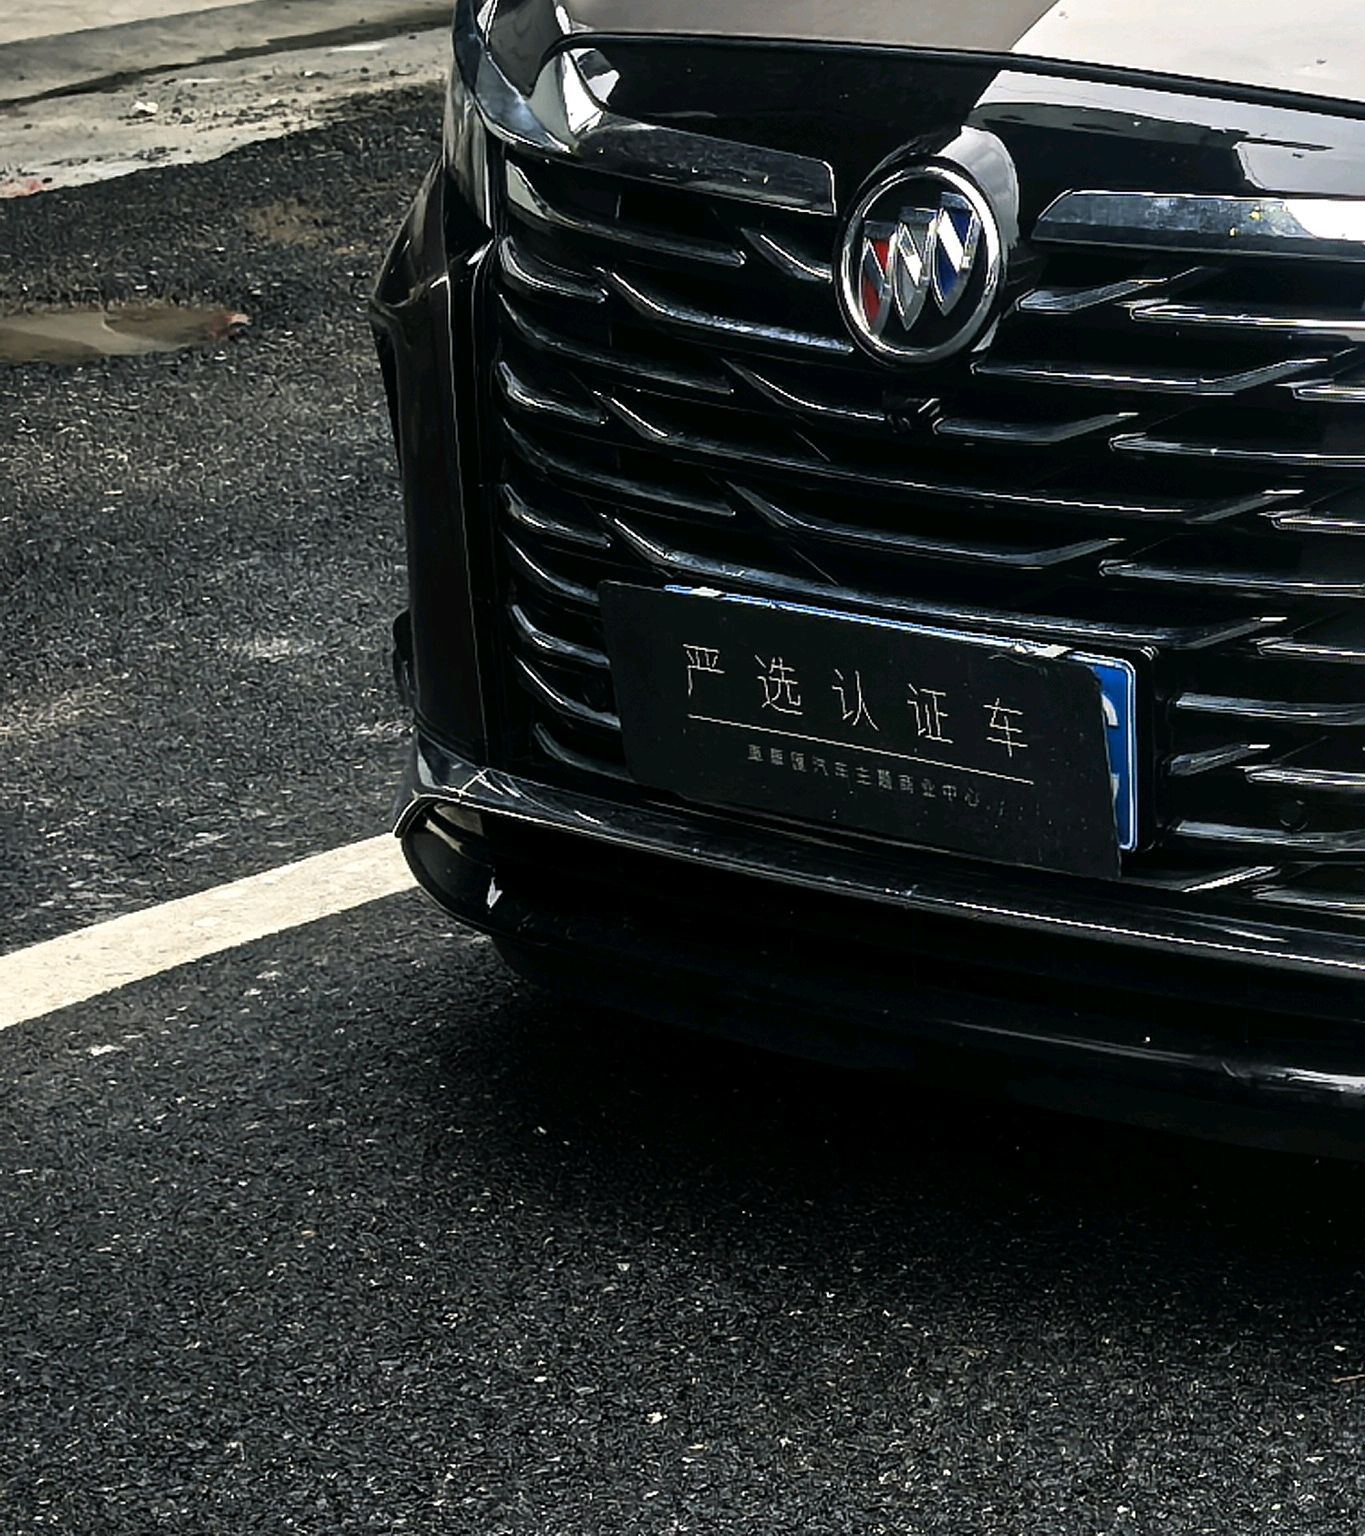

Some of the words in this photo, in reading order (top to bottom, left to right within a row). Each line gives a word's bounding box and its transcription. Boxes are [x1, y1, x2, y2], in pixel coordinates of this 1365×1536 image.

[683, 643, 1028, 757] 严选认证车
